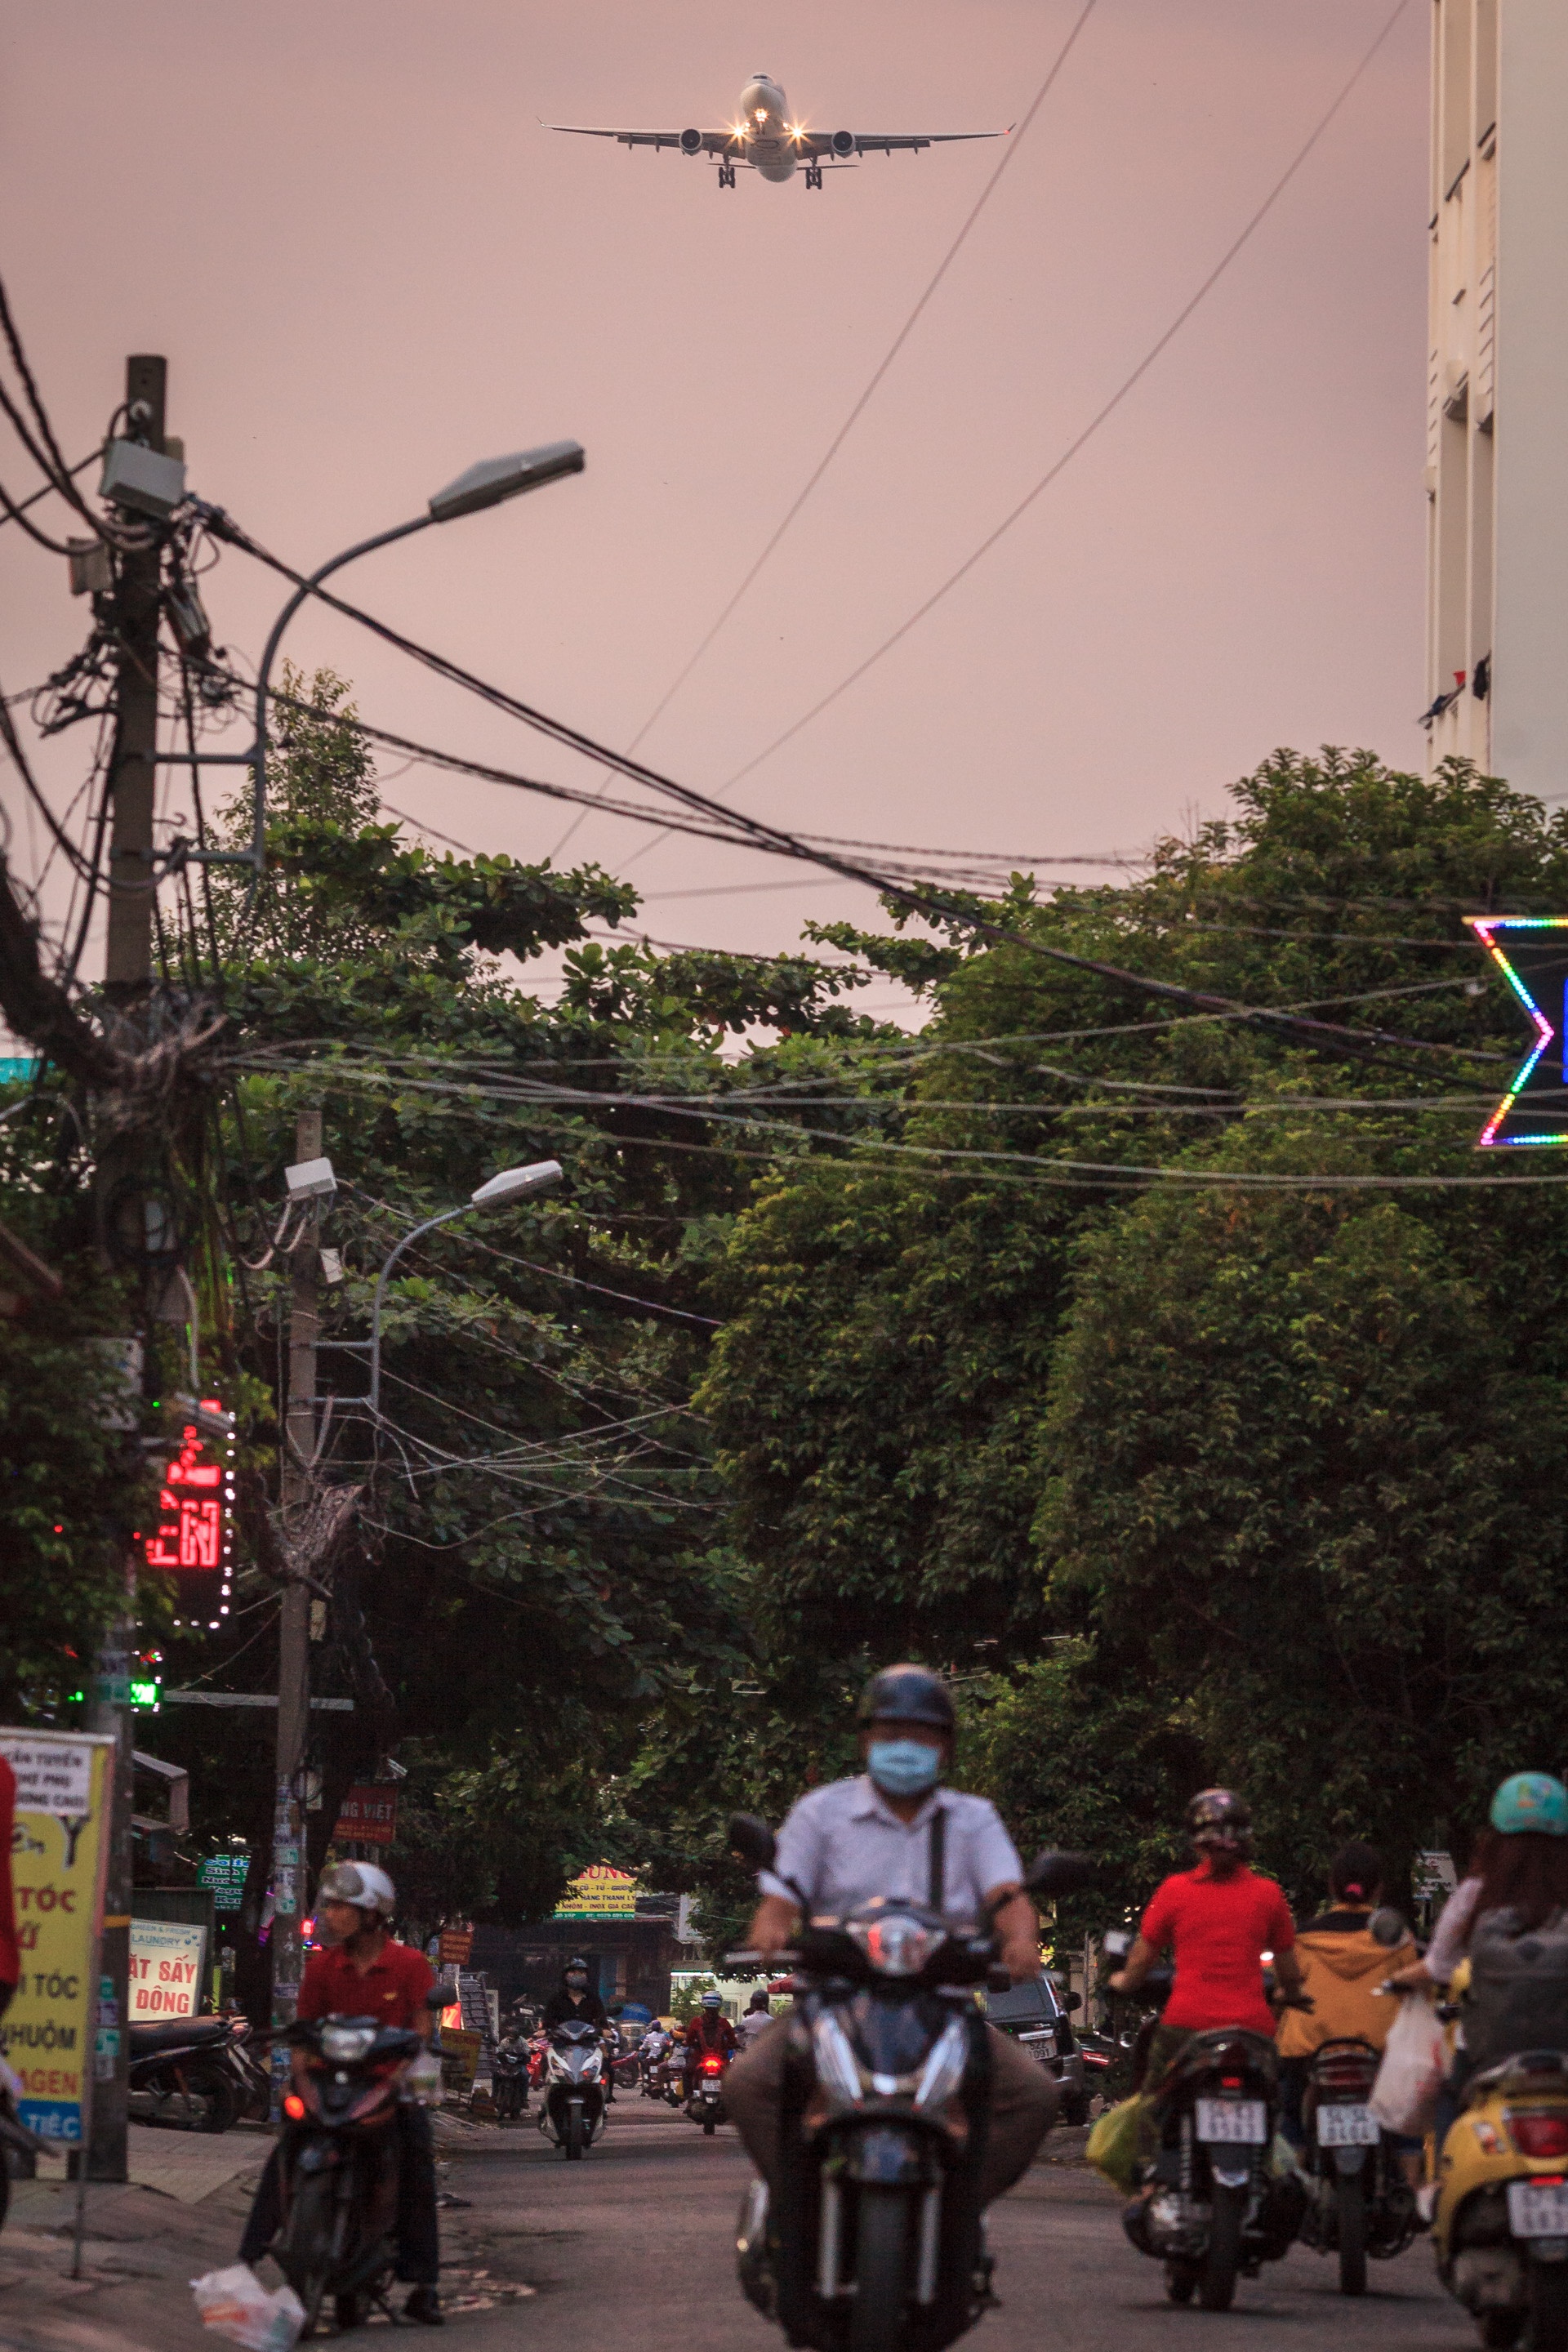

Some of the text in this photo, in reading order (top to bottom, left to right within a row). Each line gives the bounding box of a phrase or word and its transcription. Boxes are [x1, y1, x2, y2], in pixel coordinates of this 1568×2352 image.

[16, 1882, 77, 1914] TÓC
[131, 1933, 181, 1945] LAUNDRY
[33, 1967, 79, 2000] TÓC
[158, 1953, 197, 1984] SẤY
[136, 1984, 190, 2014] ĐỘNG
